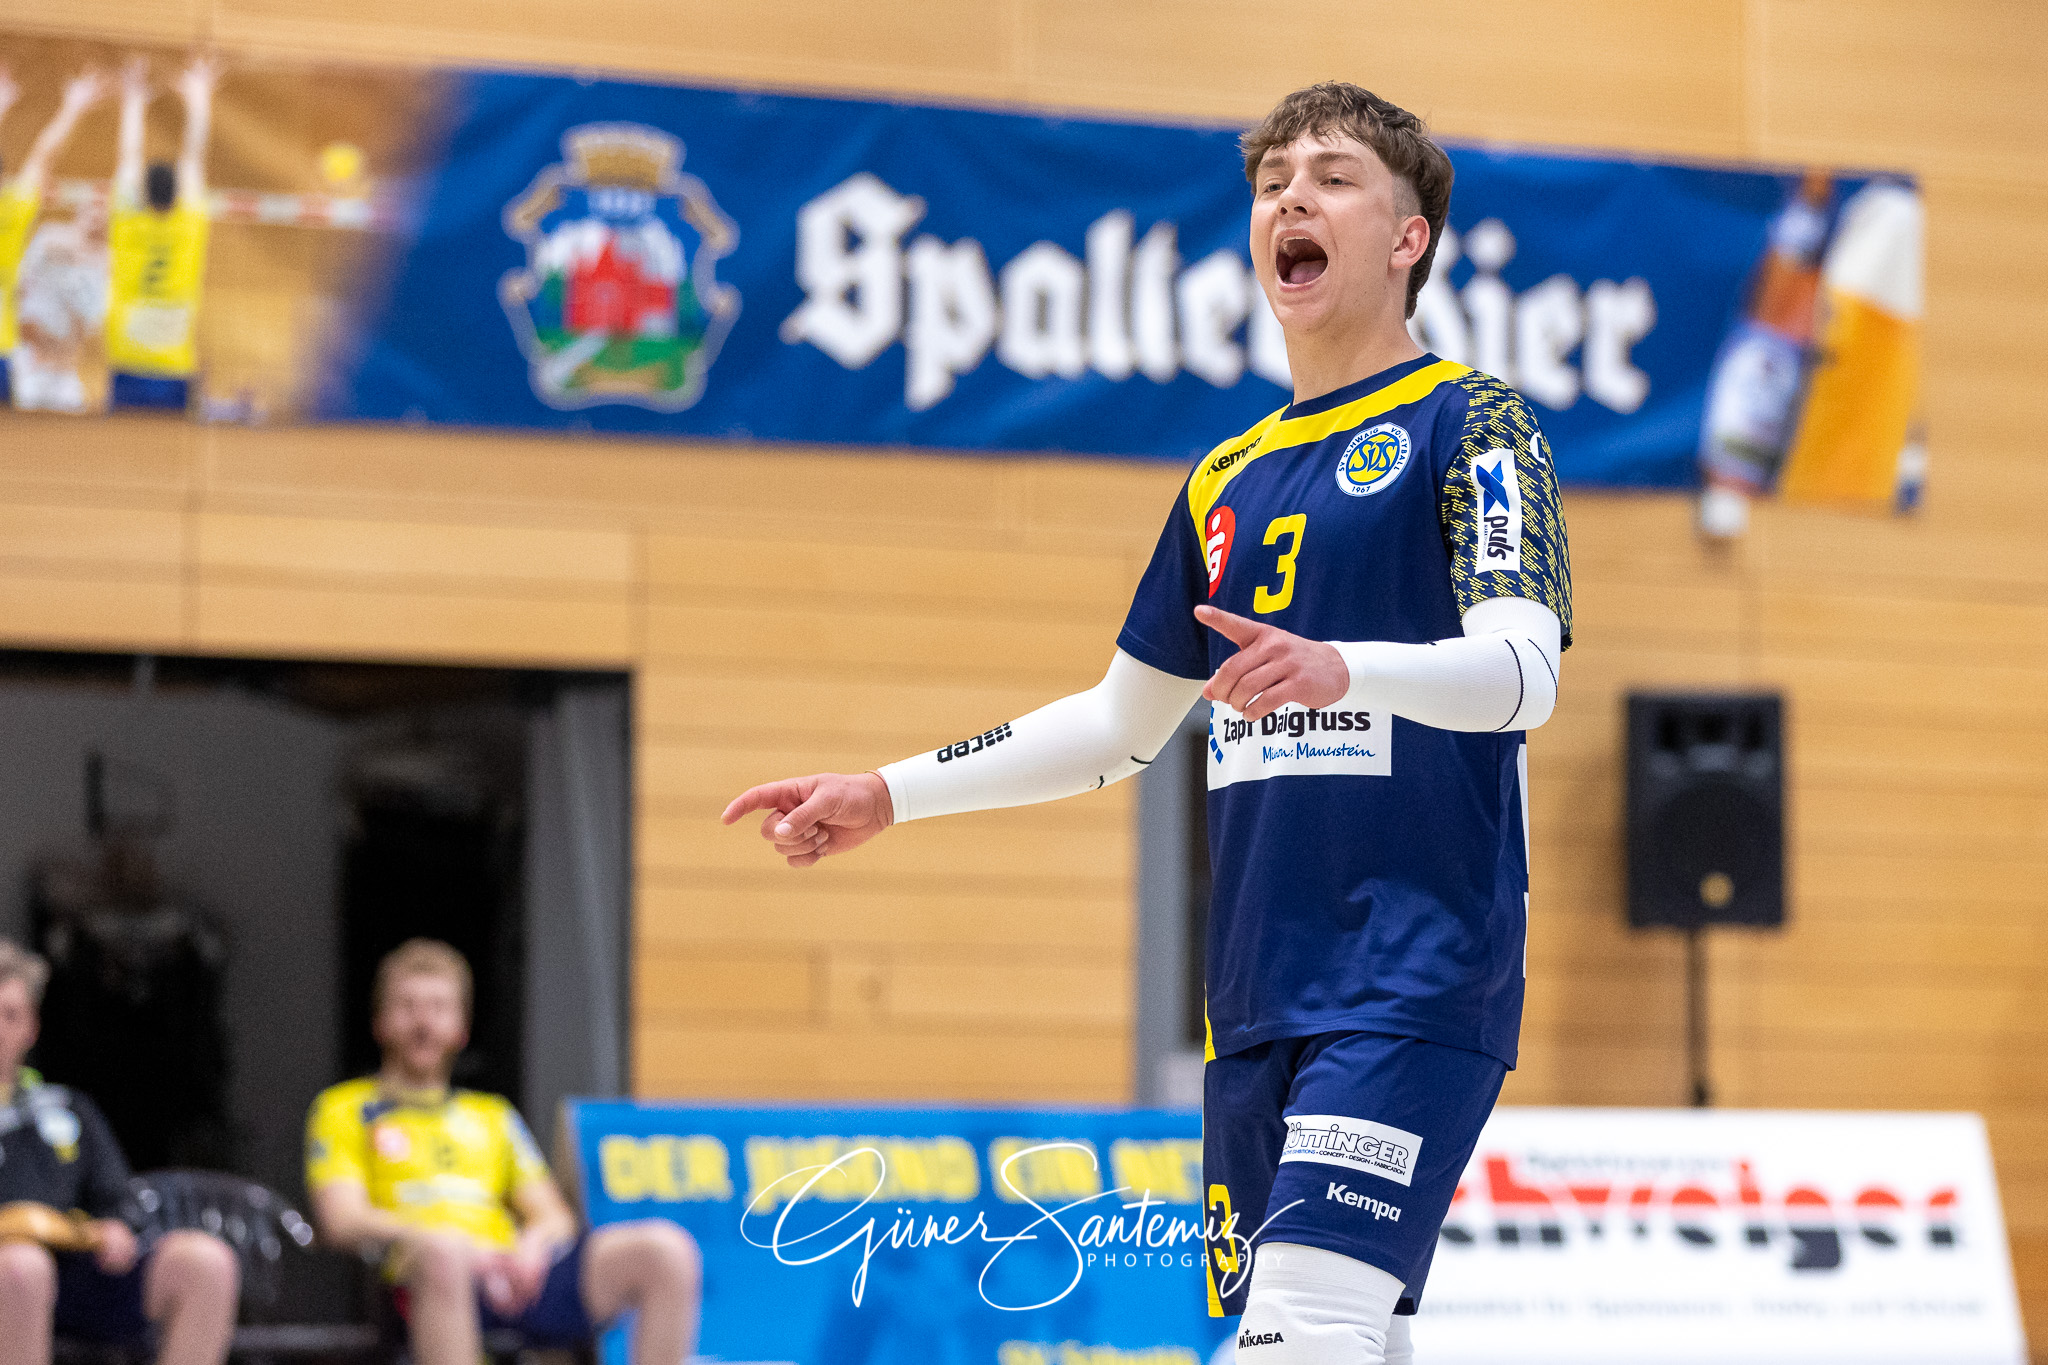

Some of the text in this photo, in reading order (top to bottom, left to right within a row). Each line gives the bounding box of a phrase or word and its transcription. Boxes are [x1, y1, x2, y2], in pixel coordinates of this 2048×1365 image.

[1484, 515, 1515, 561] puls
[1253, 513, 1307, 614] 3
[1296, 742, 1376, 760] Mauerstein
[1325, 1181, 1402, 1222] Kempa
[1438, 1153, 1958, 1274] chweiger
[1208, 1183, 1239, 1274] 3
[1238, 1330, 1285, 1350] MIKASA
